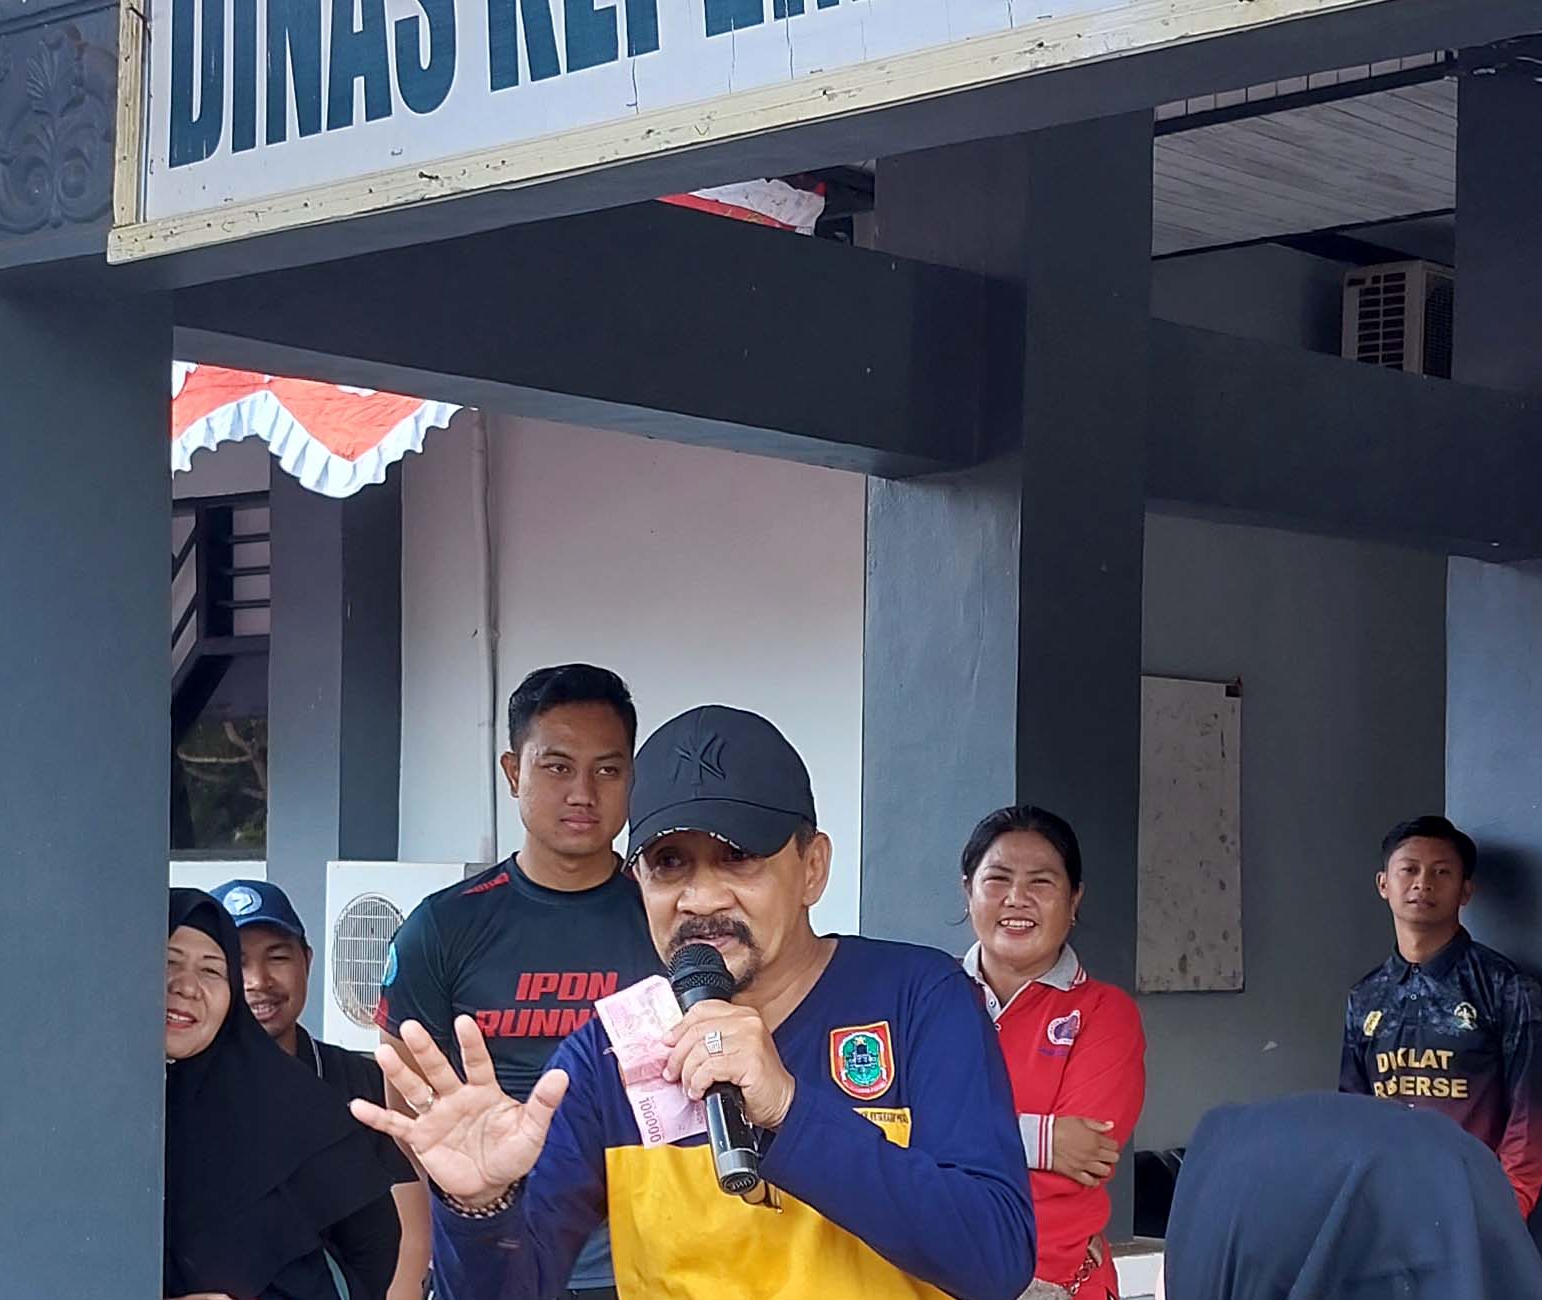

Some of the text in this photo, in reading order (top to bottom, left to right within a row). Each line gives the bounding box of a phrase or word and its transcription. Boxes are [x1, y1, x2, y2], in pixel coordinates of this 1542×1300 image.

[515, 972, 618, 1001] IPDN
[475, 1008, 597, 1037] RUNN
[1376, 1047, 1454, 1073] DIKLAT
[638, 1097, 662, 1143] 100000
